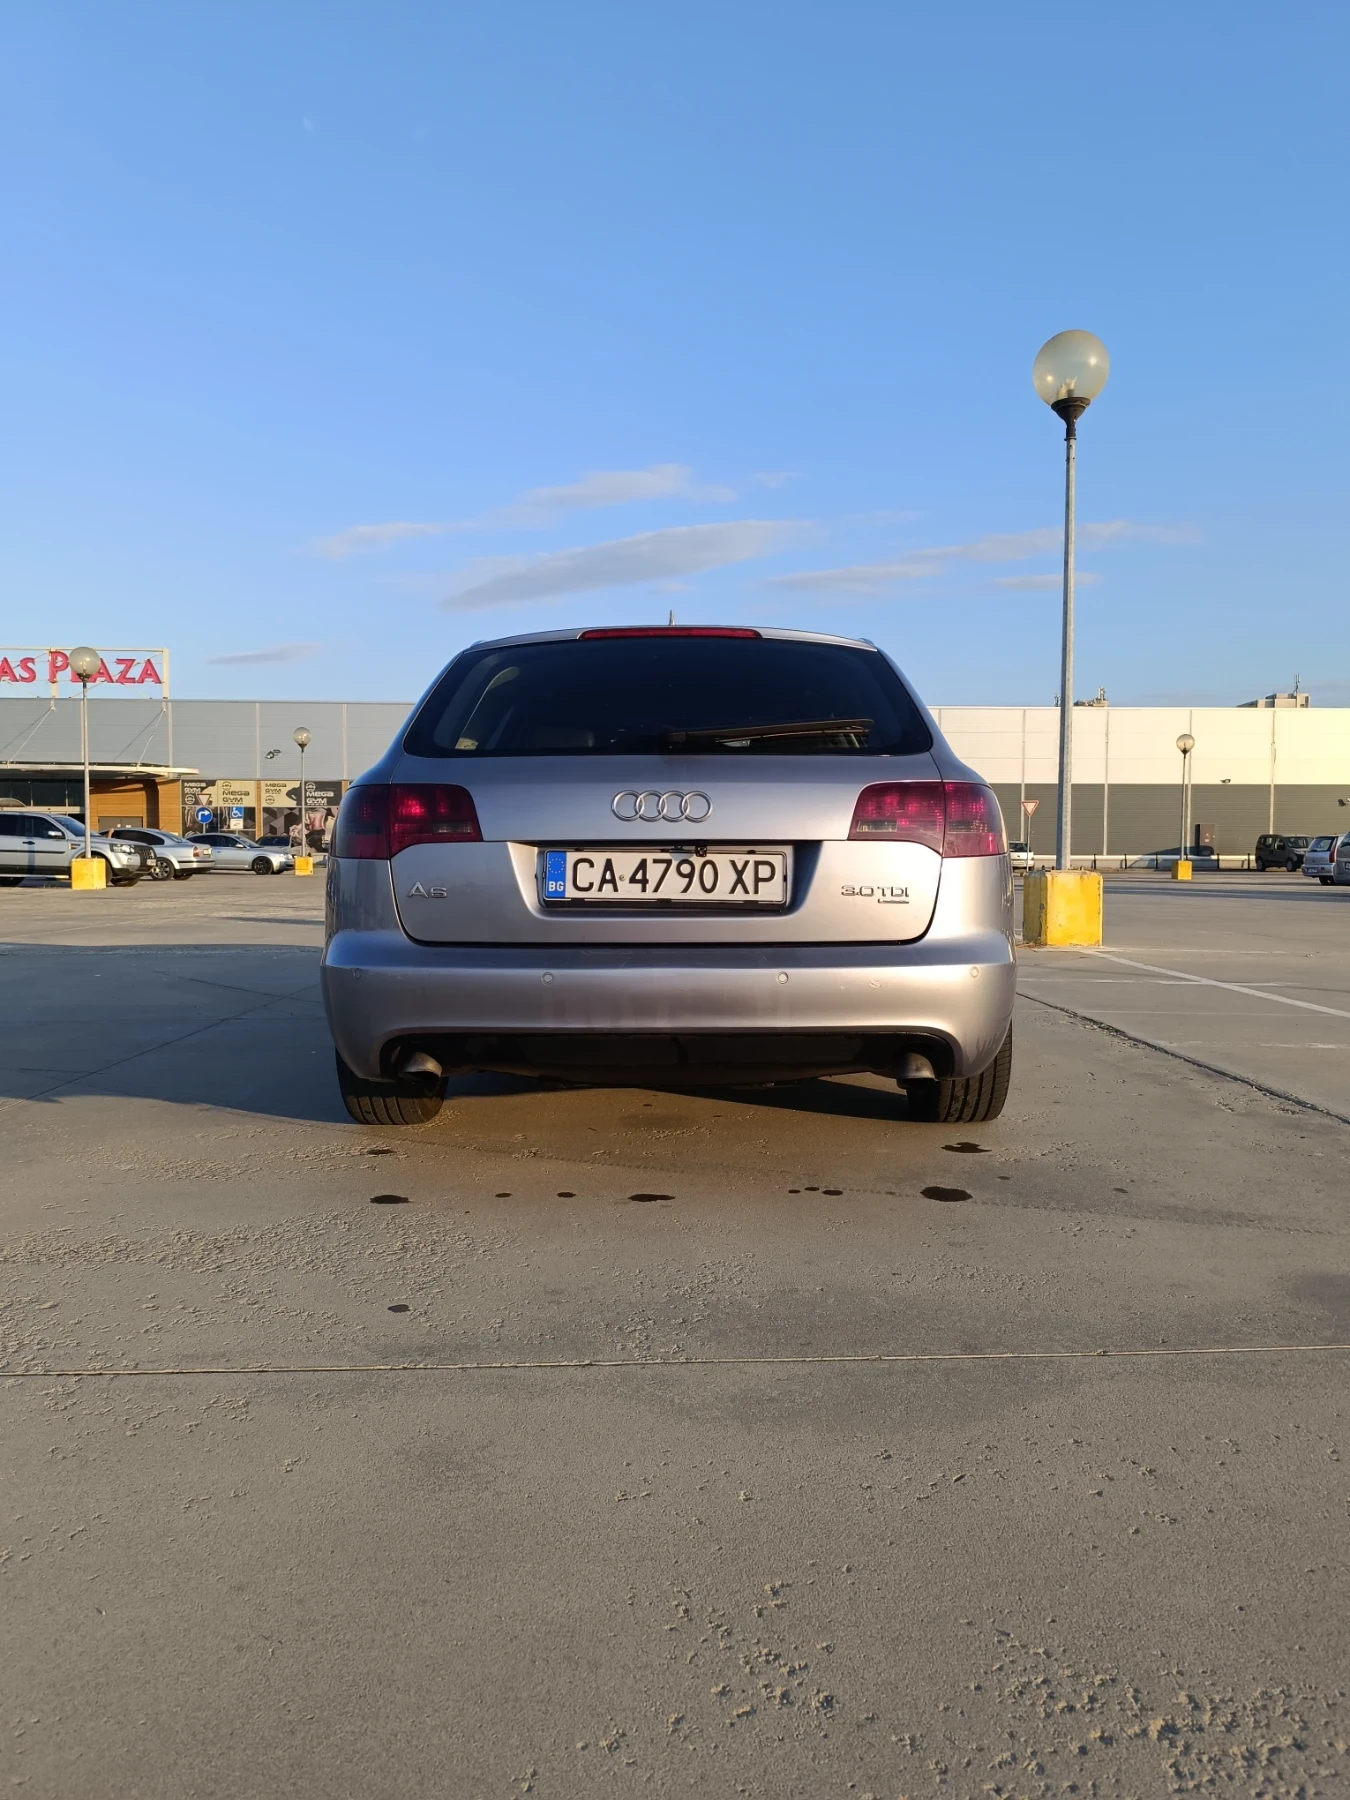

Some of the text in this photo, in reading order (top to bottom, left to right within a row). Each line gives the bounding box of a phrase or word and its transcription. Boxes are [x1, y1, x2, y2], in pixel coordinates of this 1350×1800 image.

[572, 858, 776, 895] CA 4790 XP
[548, 881, 564, 892] BG
[841, 885, 909, 897] 3.0 TDI
